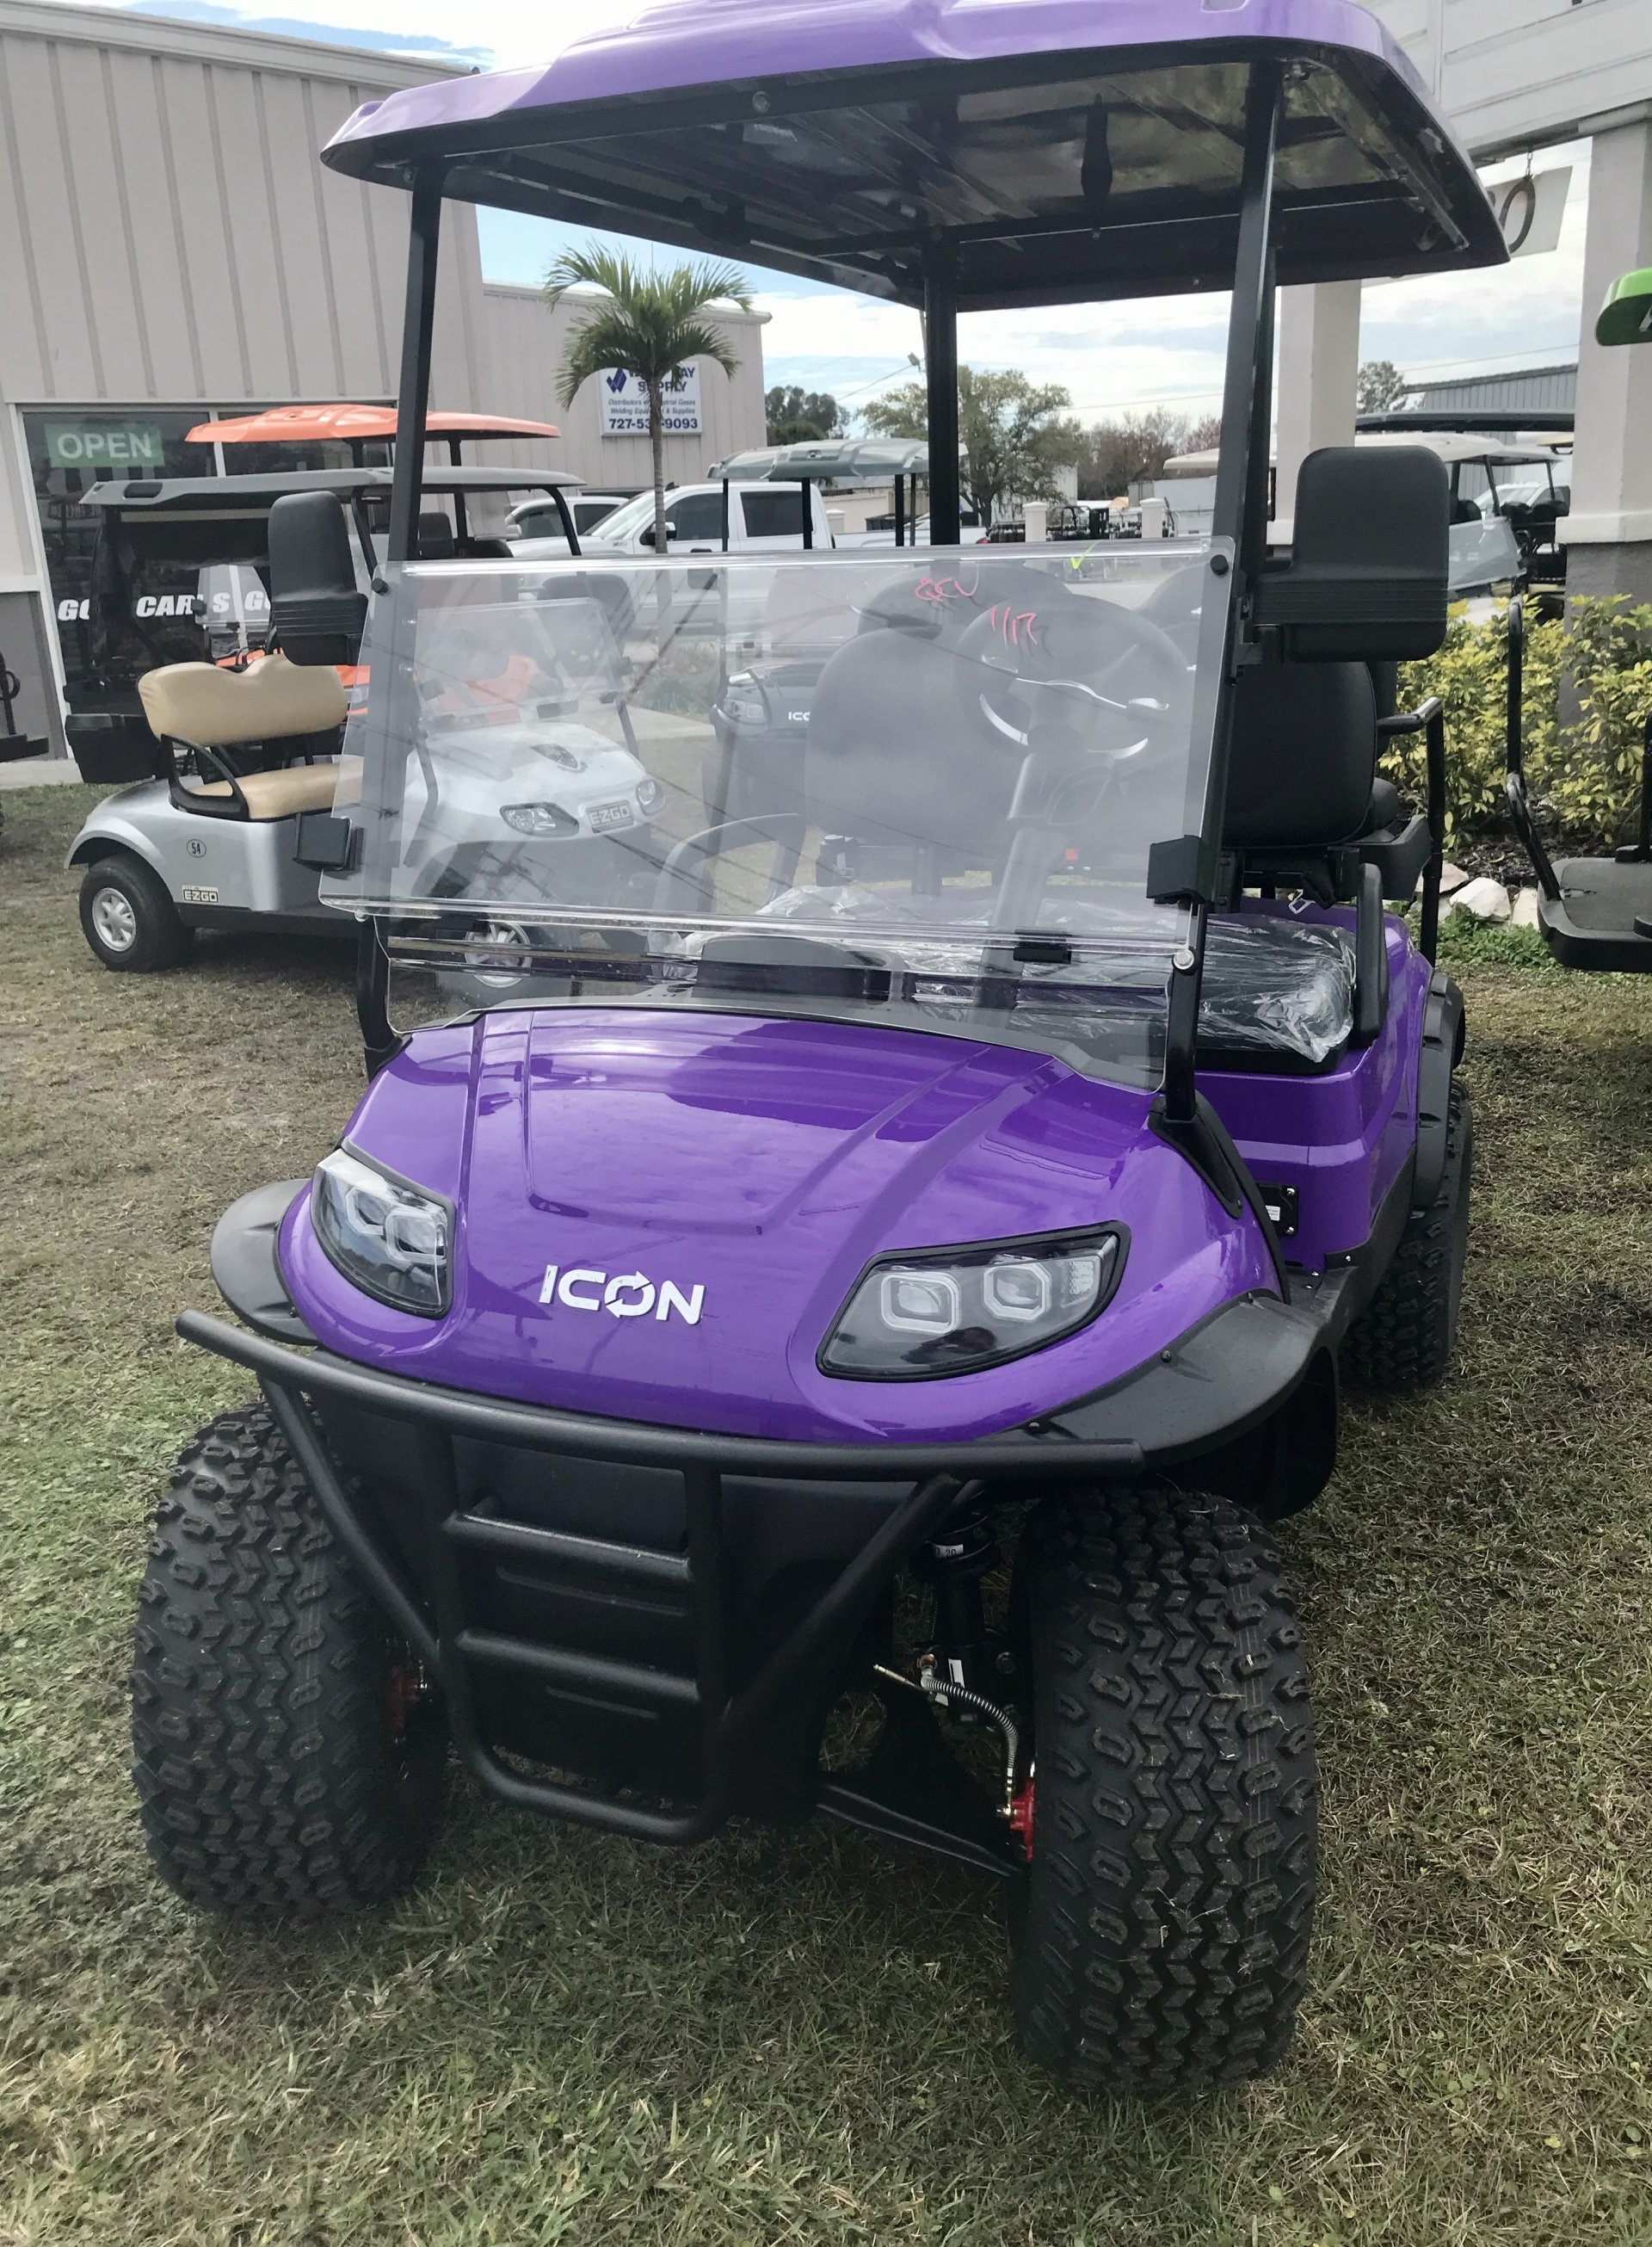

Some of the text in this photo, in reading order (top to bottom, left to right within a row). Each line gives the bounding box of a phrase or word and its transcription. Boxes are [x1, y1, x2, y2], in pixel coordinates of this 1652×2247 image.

[638, 381, 687, 392] SPPLY
[610, 407, 633, 416] Welding
[672, 407, 695, 416] Supplies
[608, 418, 699, 429] 727-53-9093
[57, 432, 152, 459] OPEN
[136, 592, 231, 618] CARS
[787, 711, 811, 722] ICO
[191, 842, 201, 855] 54
[539, 1264, 706, 1325] ICON
